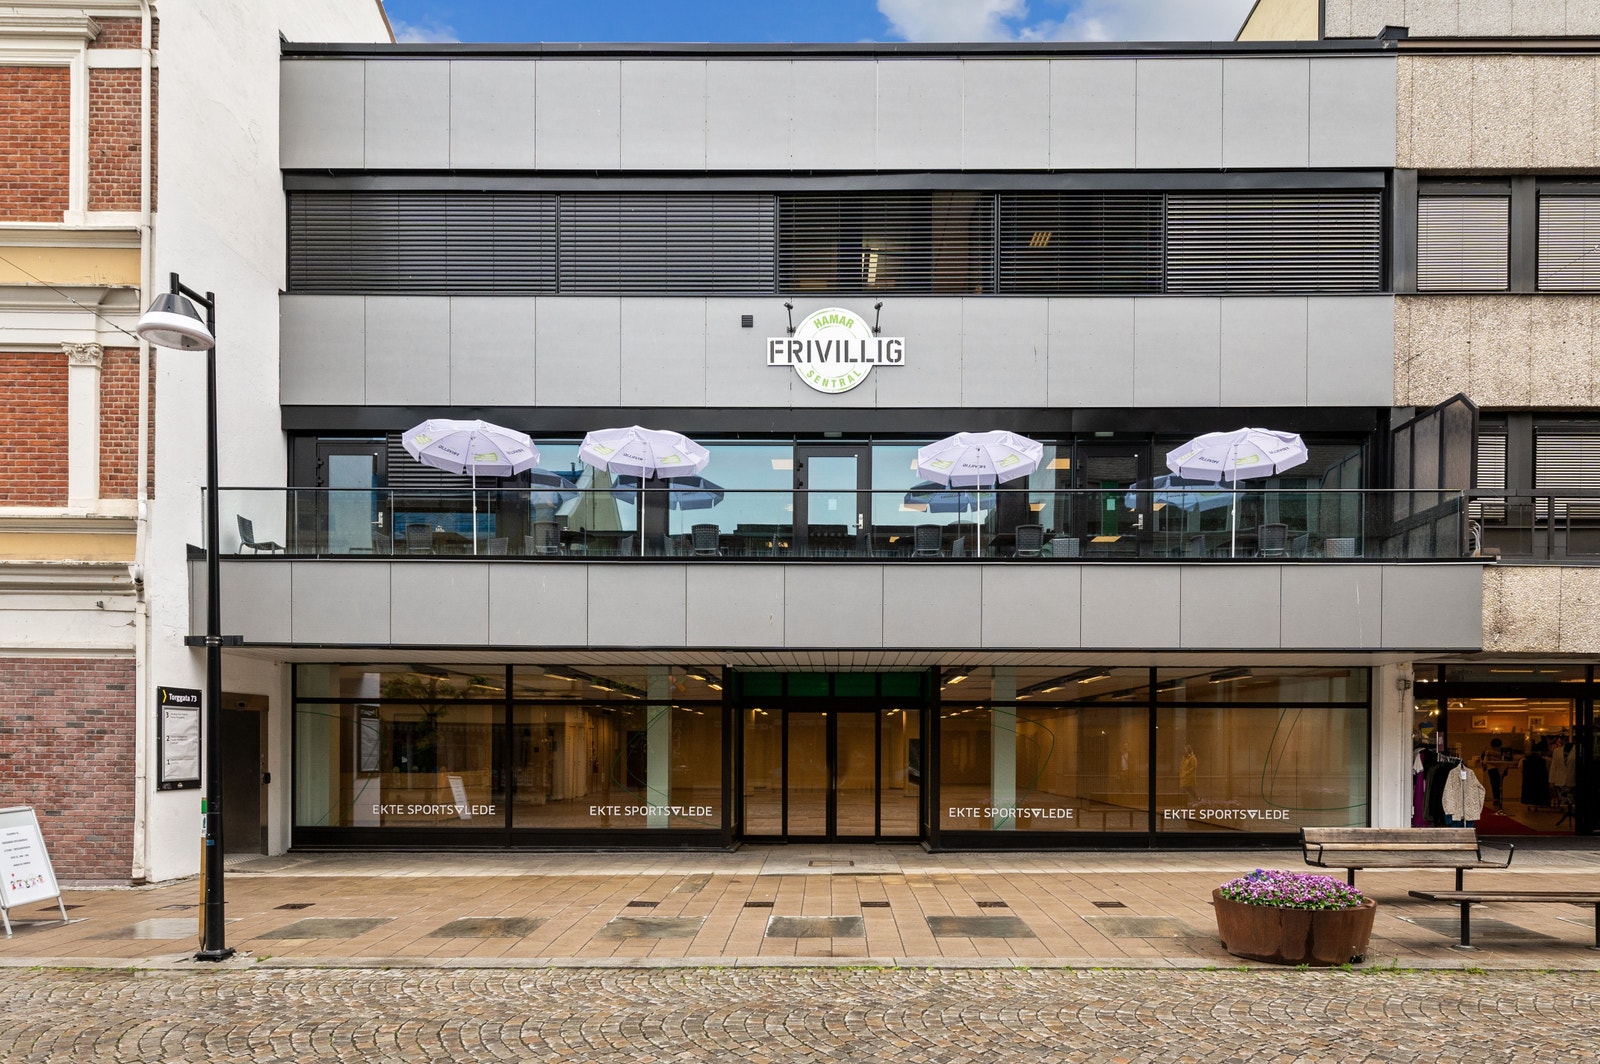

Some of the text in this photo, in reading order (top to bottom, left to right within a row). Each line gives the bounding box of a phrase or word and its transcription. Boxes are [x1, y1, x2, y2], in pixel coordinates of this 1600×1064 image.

[813, 314, 855, 329] HAMAR
[769, 339, 902, 364] FRIVILLIG
[806, 369, 861, 388] SENTRAL
[168, 693, 190, 703] Torggata
[372, 804, 404, 815] EKTE
[589, 805, 621, 816] EKTE
[949, 807, 981, 818] EKTE
[1164, 809, 1196, 820] EKTE
